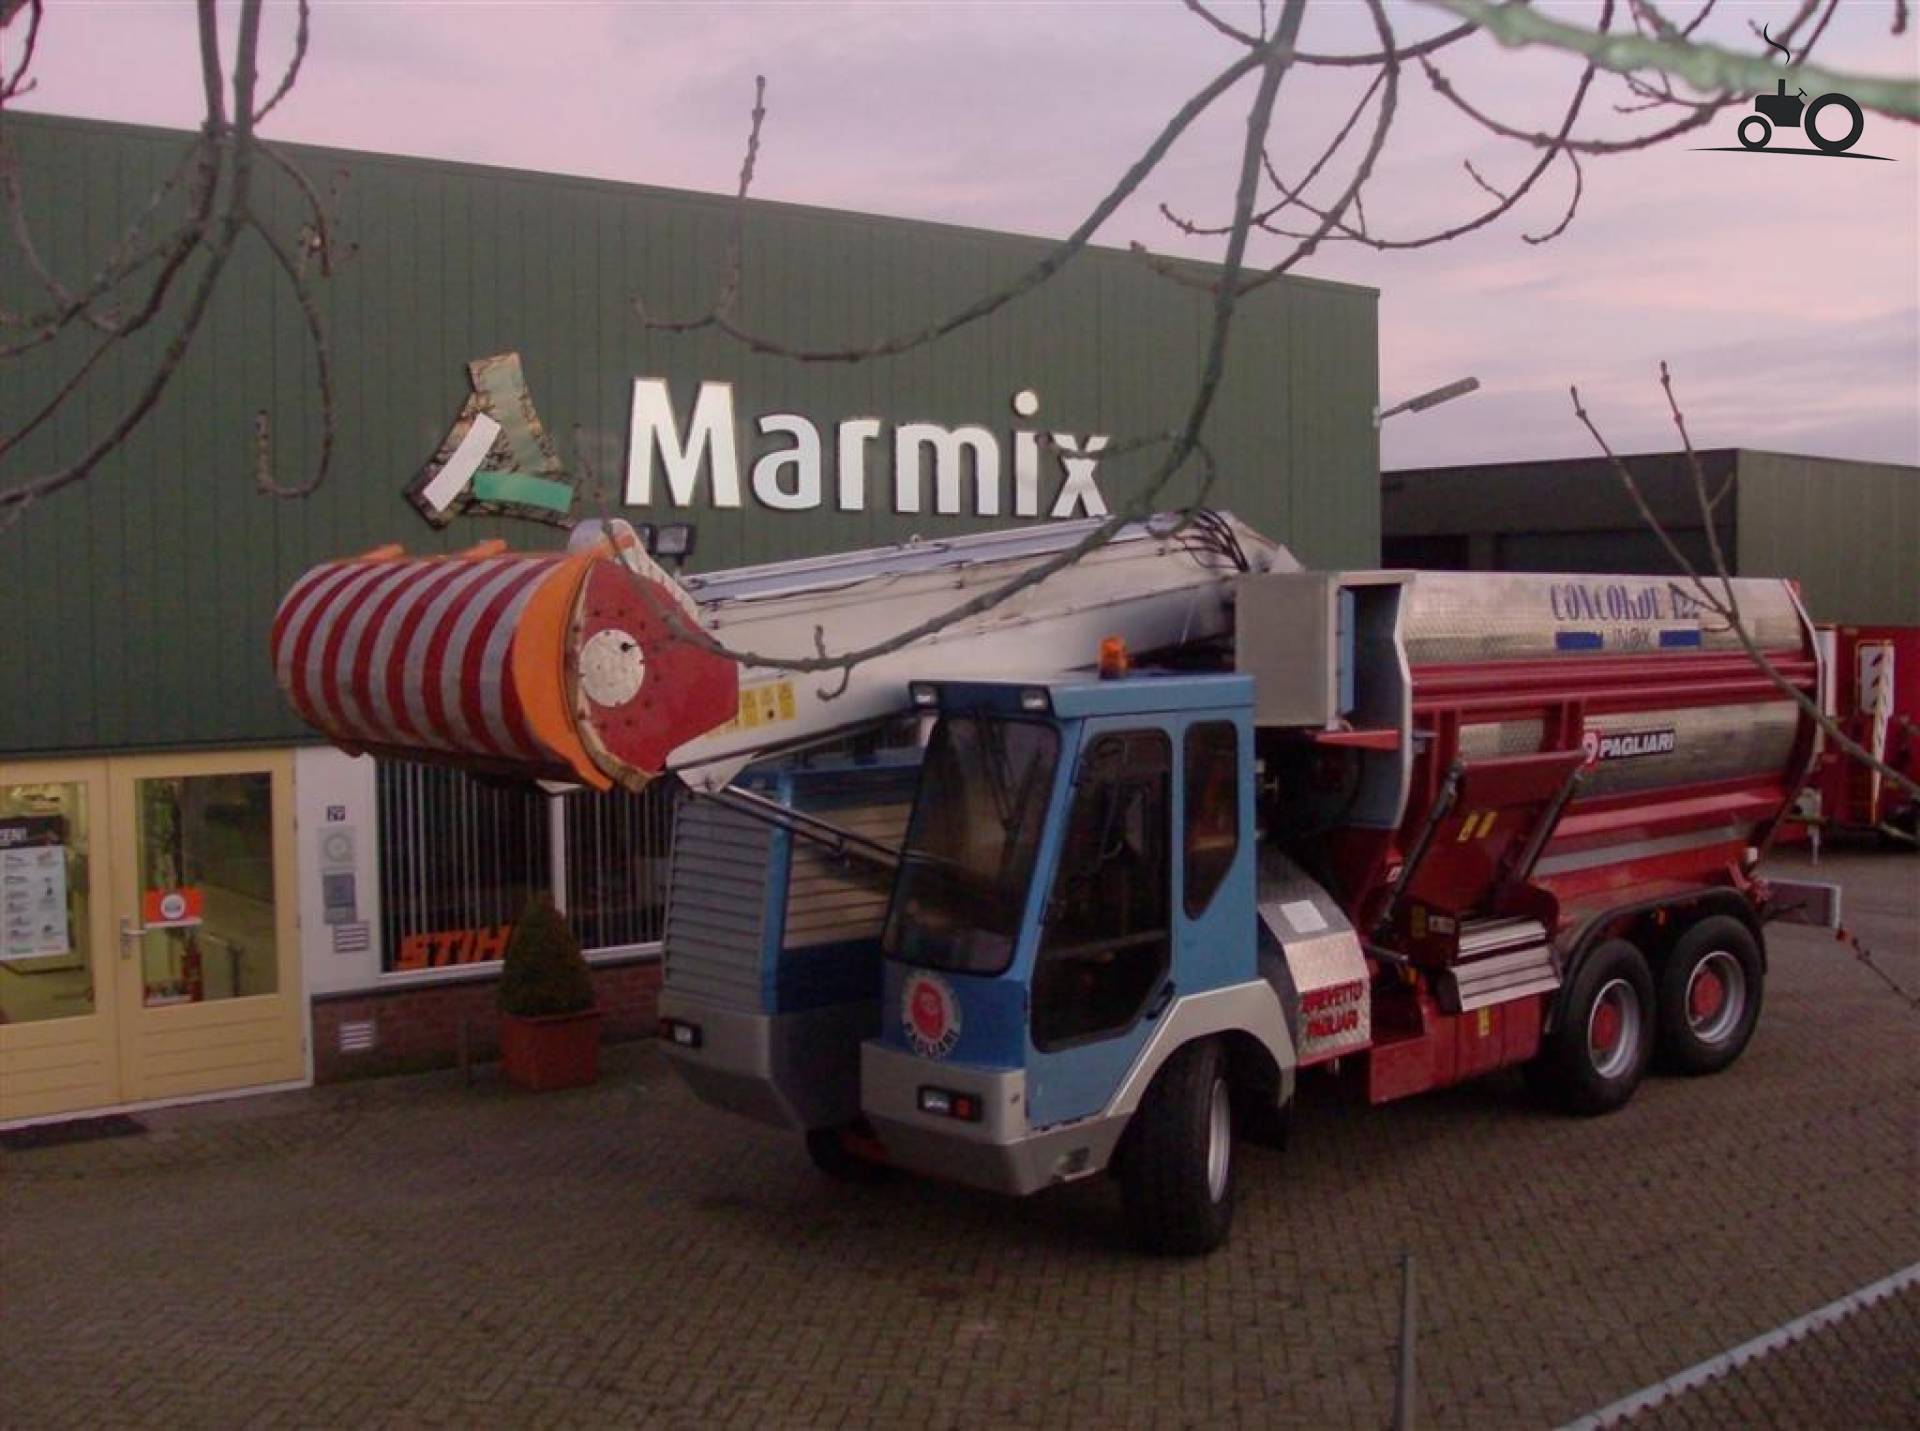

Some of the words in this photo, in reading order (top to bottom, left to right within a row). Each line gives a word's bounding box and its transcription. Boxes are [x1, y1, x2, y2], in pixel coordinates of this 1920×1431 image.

[624, 376, 1110, 518] Marmix
[1599, 733, 1675, 757] PAGLIARI
[397, 926, 511, 969] STIH
